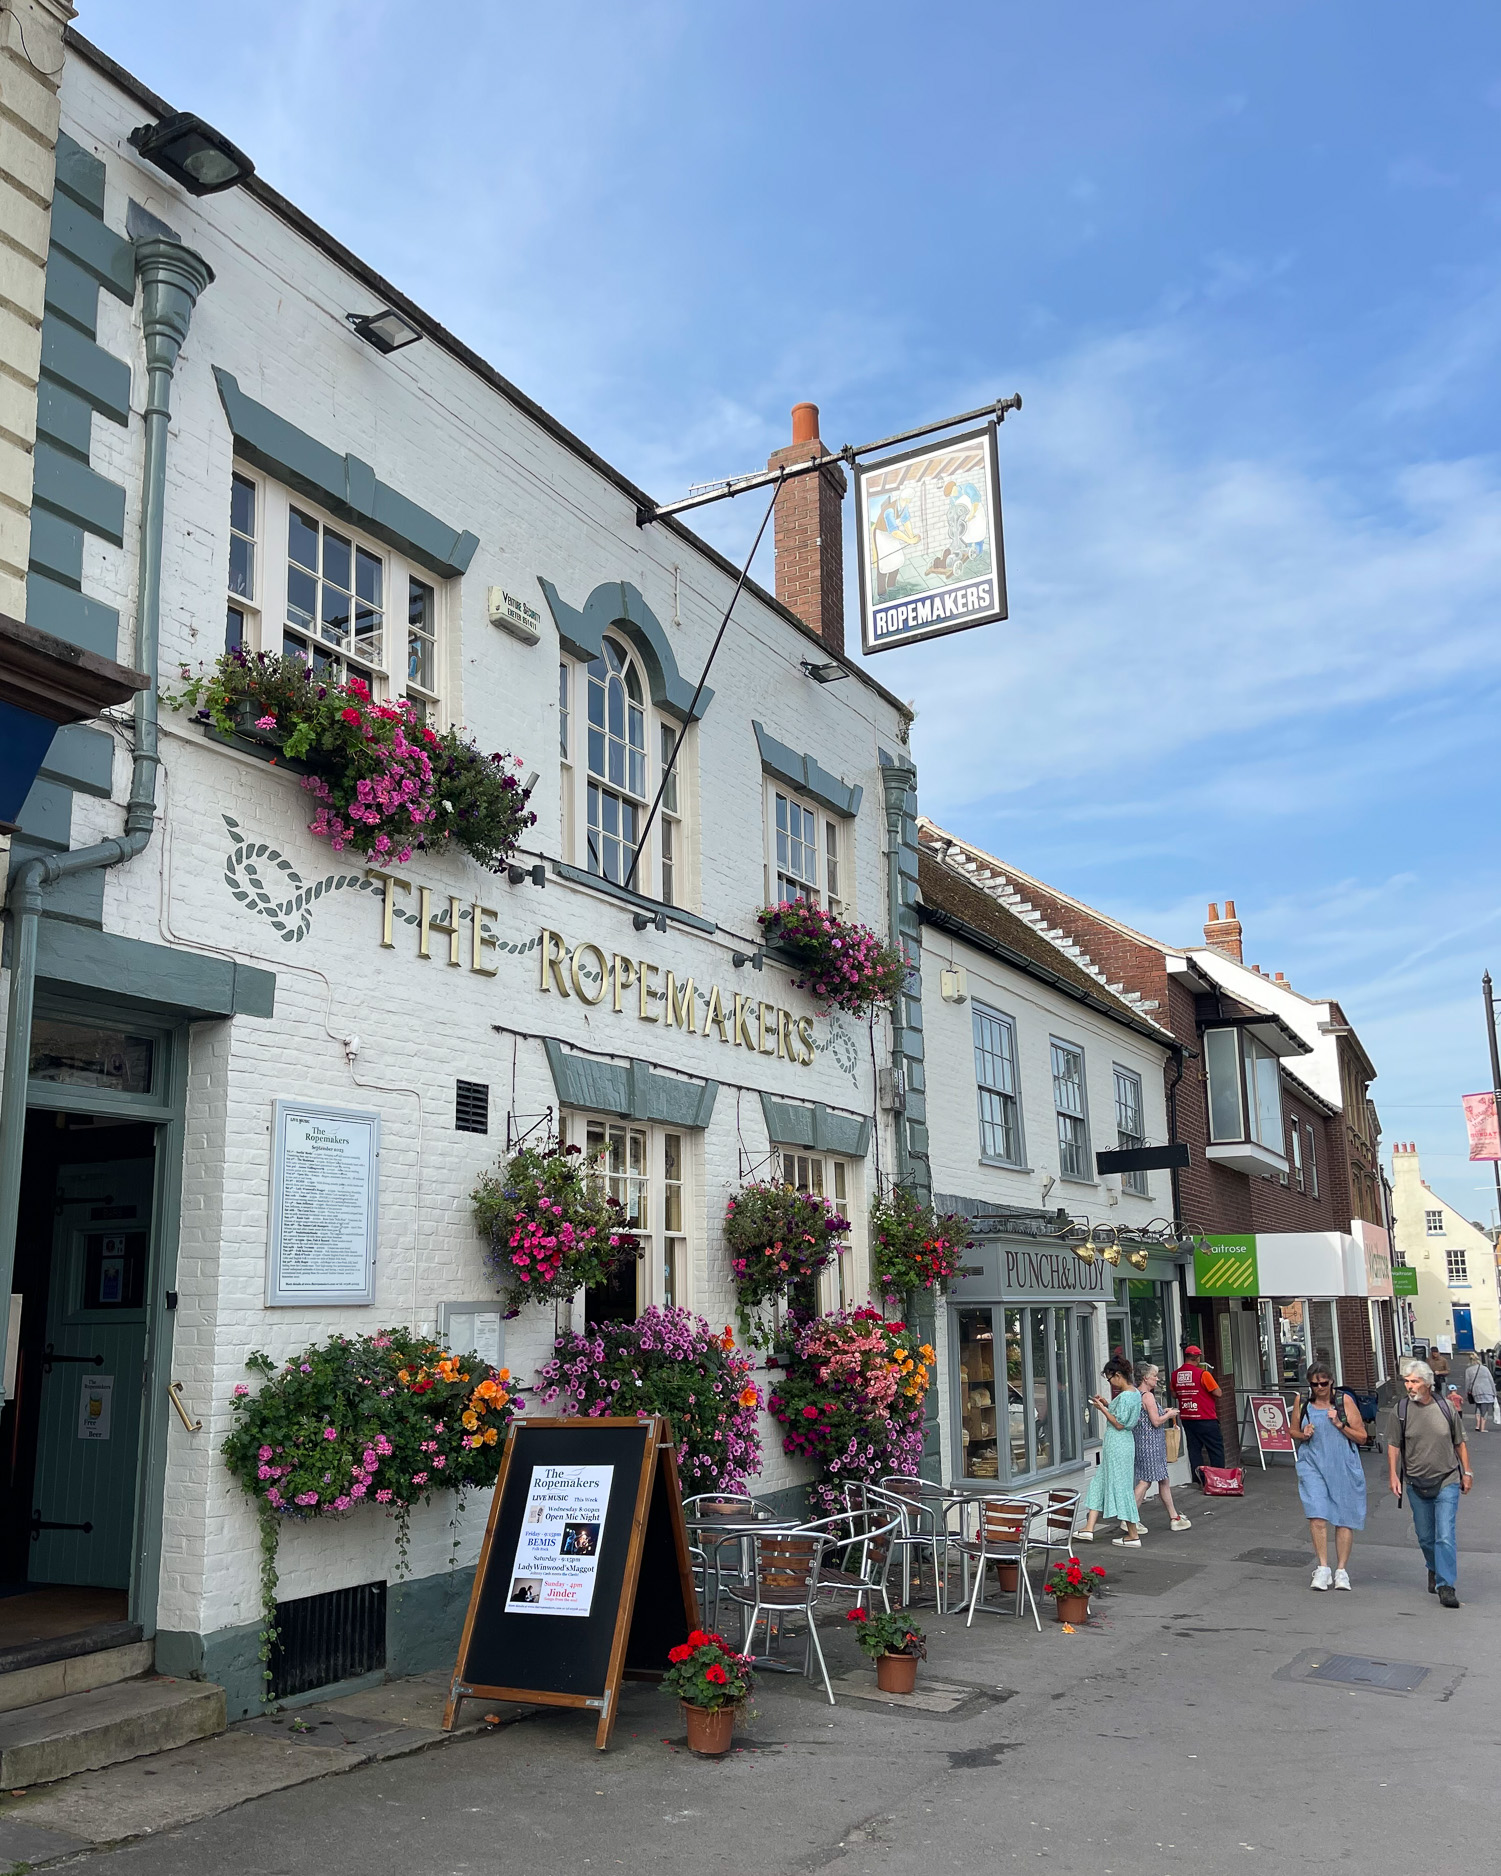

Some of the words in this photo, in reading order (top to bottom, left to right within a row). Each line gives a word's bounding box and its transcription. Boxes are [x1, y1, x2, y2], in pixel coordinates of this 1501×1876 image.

[876, 583, 990, 635] ROPEMAKERS
[367, 868, 499, 978] THE
[539, 927, 815, 1067] ROPEMAKERS
[312, 1126, 326, 1135] The
[305, 1133, 350, 1145] Ropemakers
[311, 1144, 333, 1152] September
[1211, 1243, 1247, 1254] aitrose
[83, 1418, 97, 1426] Free
[545, 1468, 565, 1479] The
[533, 1478, 600, 1490] Ropemakers
[547, 1494, 569, 1502] MUSIC
[548, 1506, 578, 1514] Wednesday
[545, 1513, 564, 1522] Open
[565, 1513, 579, 1521] Mic
[579, 1513, 600, 1522] Night
[527, 1538, 557, 1546] BEMIS
[544, 1580, 565, 1588] Sunday
[570, 1581, 583, 1589] 4pm
[547, 1588, 577, 1598] Jinder
